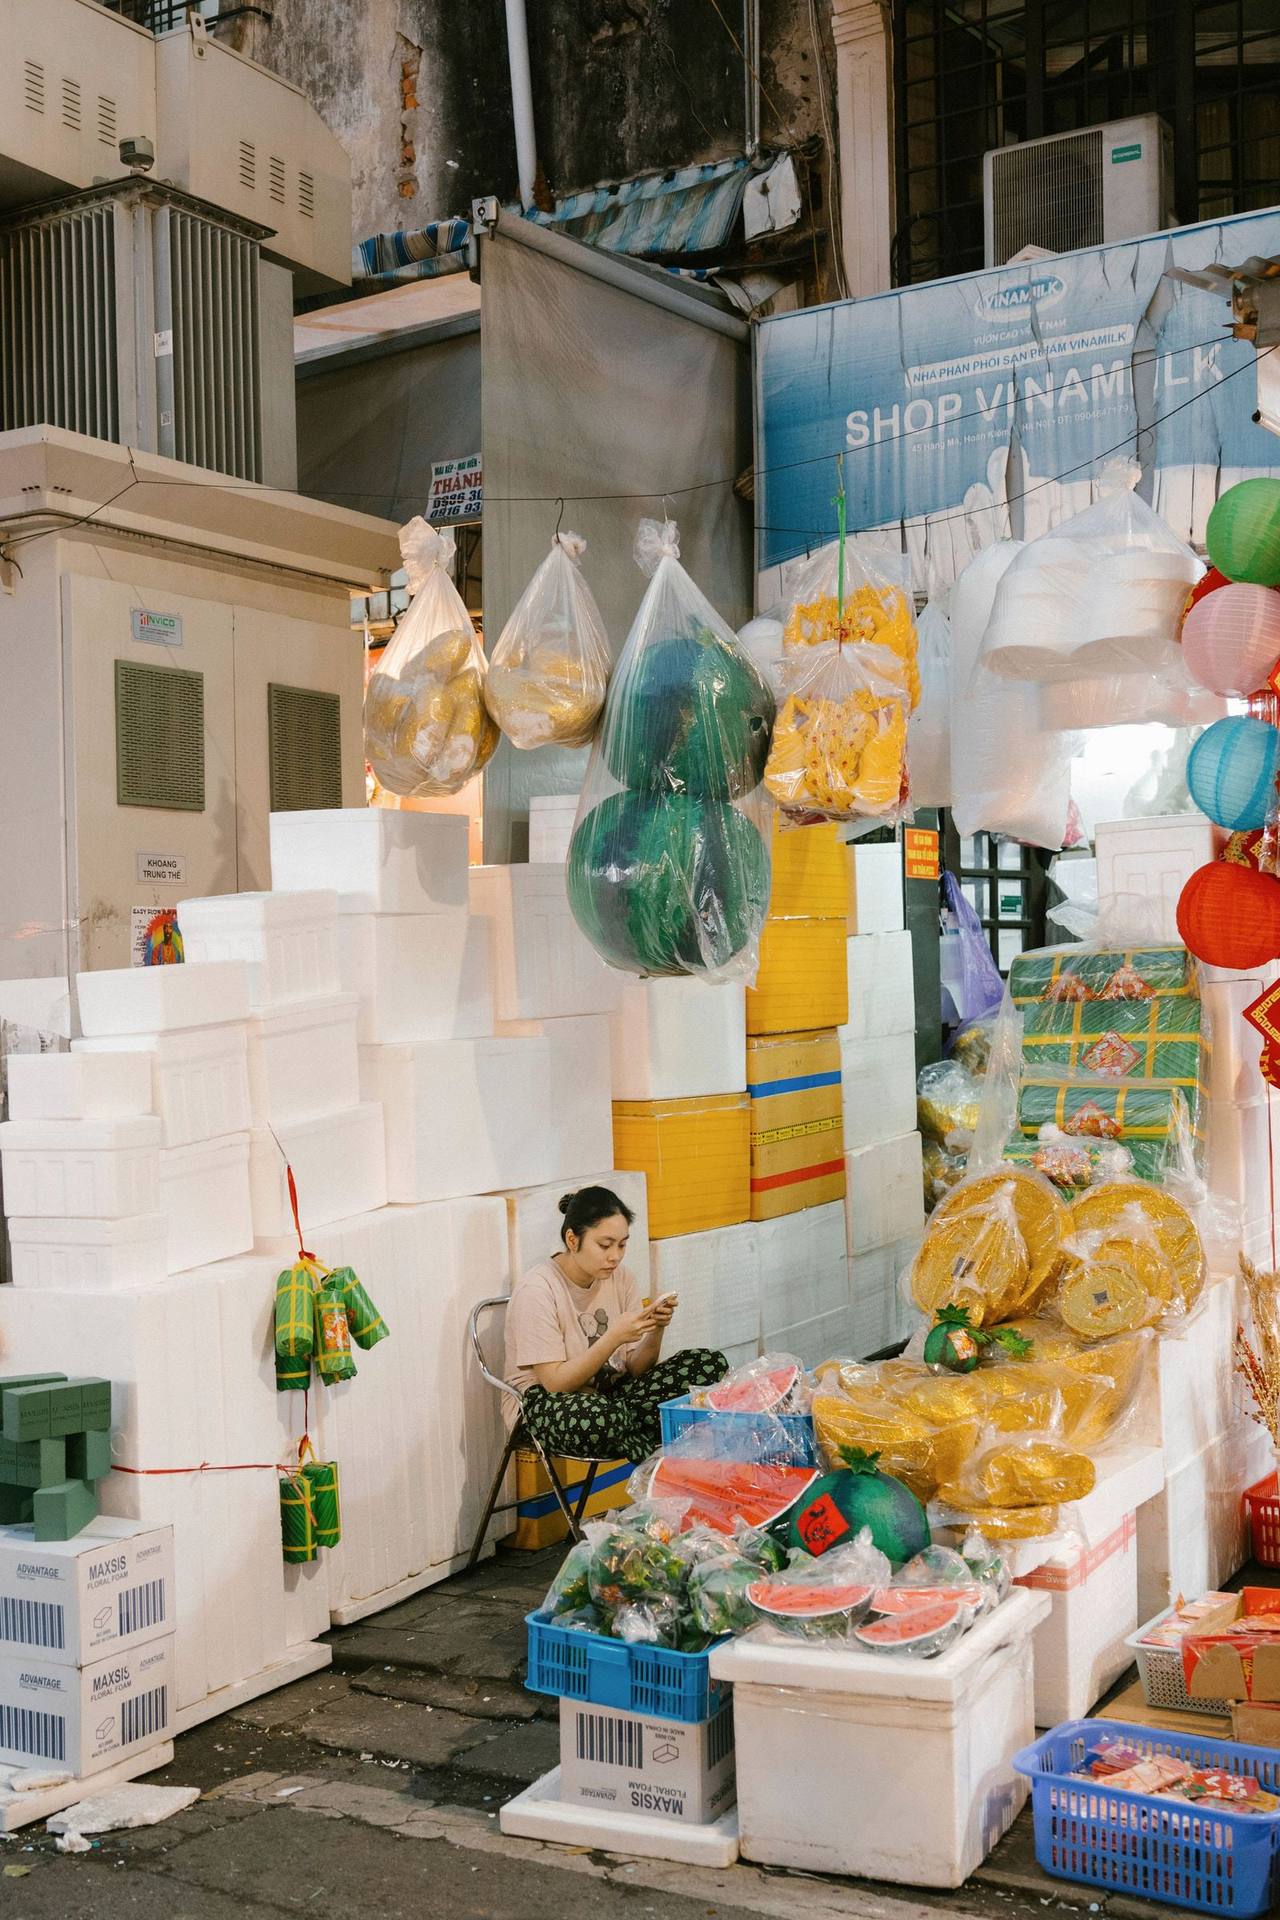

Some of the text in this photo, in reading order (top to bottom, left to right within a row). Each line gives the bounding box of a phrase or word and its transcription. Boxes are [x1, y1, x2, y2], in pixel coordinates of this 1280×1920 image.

[1069, 331, 1127, 351] VINAMILK
[846, 343, 1224, 446] SHOP VINAMLK
[147, 859, 177, 868] KHOANG
[143, 870, 166, 879] TRUNG
[17, 1563, 59, 1578] ADVANTAGE
[89, 1555, 127, 1580] MAXSIS
[87, 1570, 129, 1590] FLORAL FOAM
[20, 1673, 61, 1689] ADVANTAGE
[93, 1666, 130, 1692] MAXSIS
[90, 1679, 132, 1702] FLORAL FOAM
[628, 1780, 687, 1798] FLORAL FOAM
[631, 1791, 683, 1816] MAXSIS
